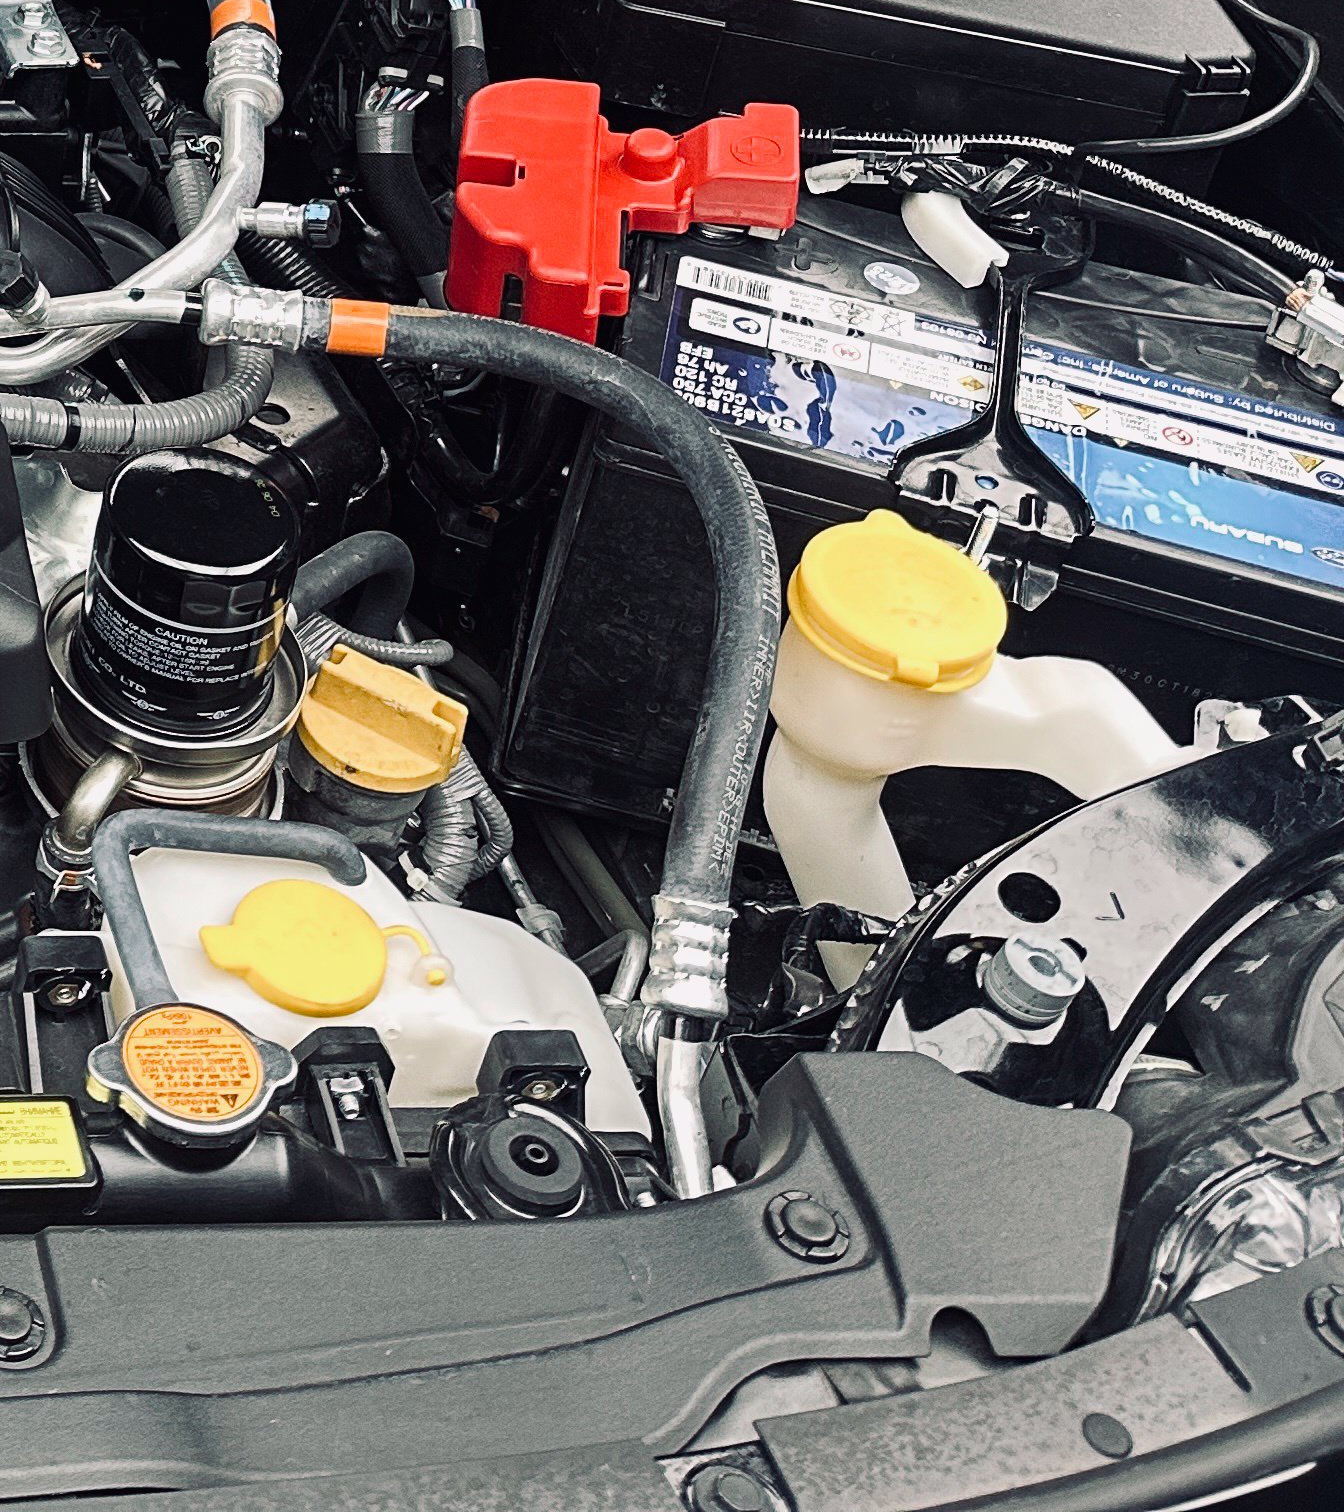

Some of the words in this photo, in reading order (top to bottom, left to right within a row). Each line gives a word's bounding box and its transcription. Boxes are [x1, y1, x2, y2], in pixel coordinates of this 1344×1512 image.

[677, 339, 714, 359] EFB
[673, 363, 706, 381] 120
[702, 358, 729, 375] Ah
[671, 375, 707, 394] 750
[708, 372, 739, 390] RC
[1151, 376, 1169, 389] of
[709, 385, 748, 405] CCA
[1169, 380, 1225, 404] Subaru
[1252, 402, 1336, 432] Distributed
[1187, 513, 1305, 555] SUBARU
[155, 627, 208, 645] CAUTION
[179, 663, 205, 671] START
